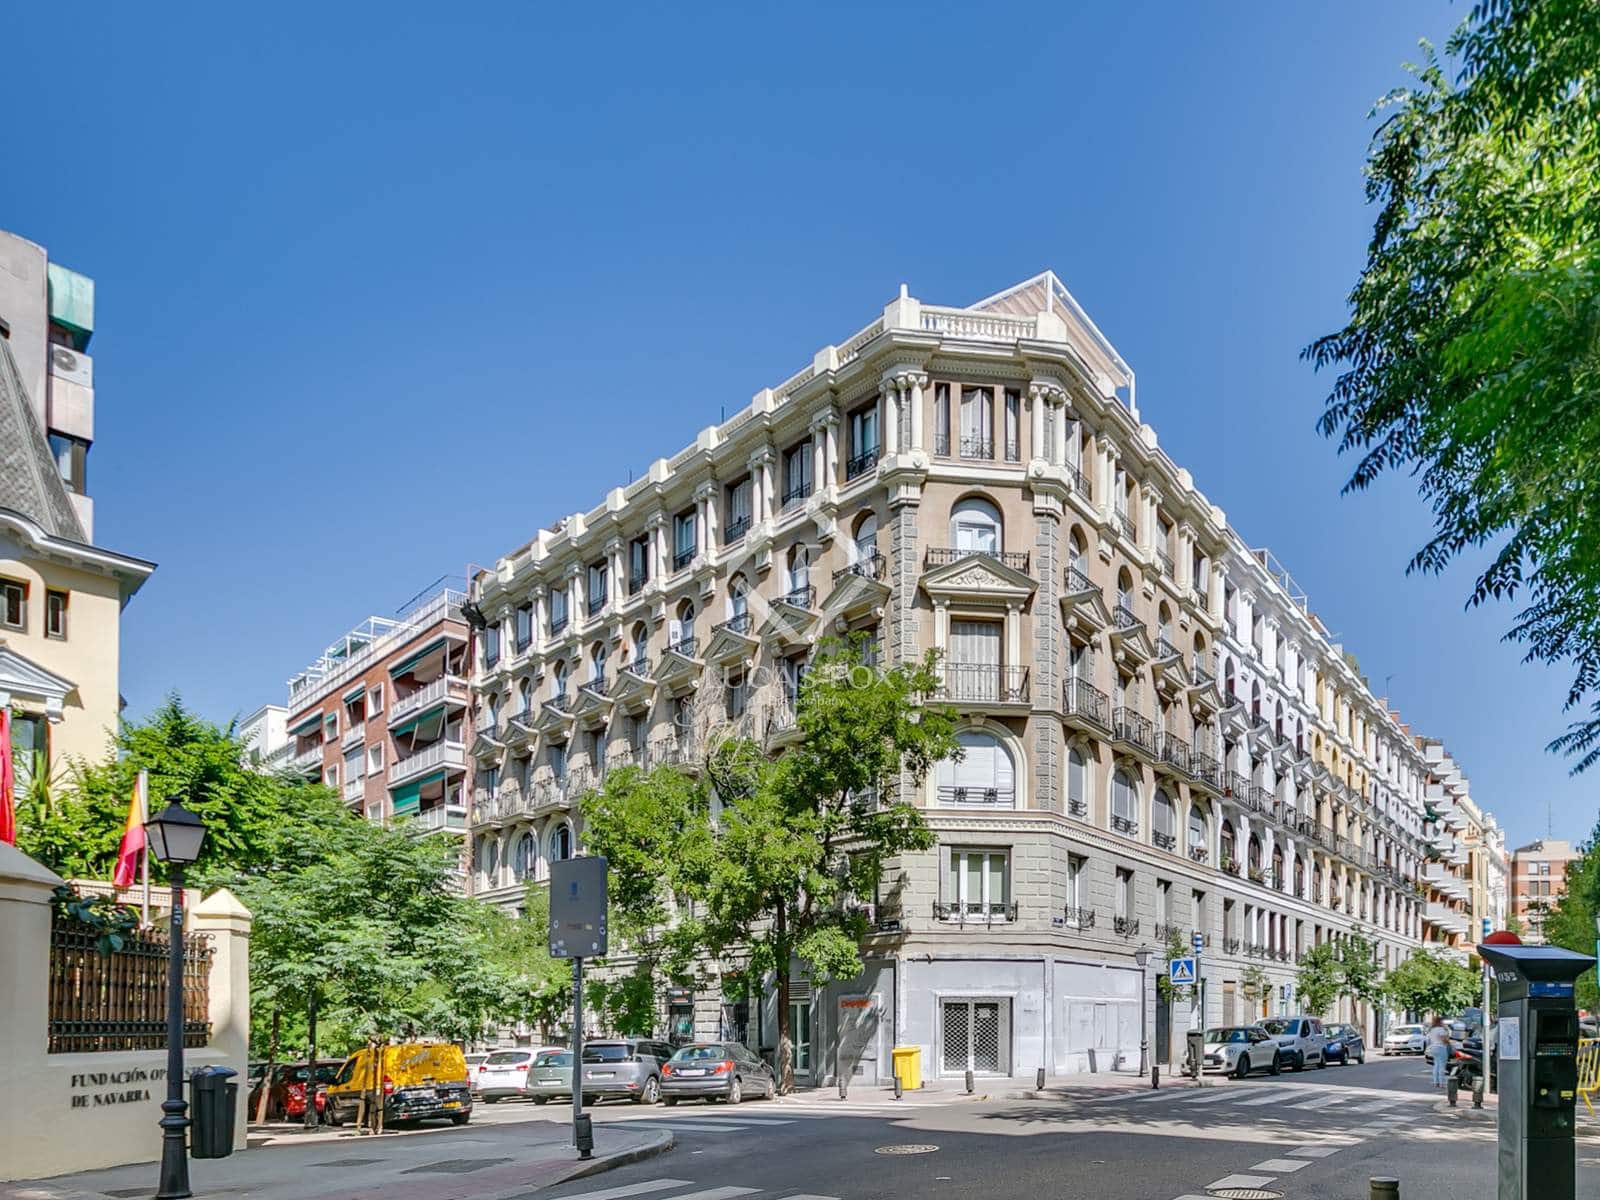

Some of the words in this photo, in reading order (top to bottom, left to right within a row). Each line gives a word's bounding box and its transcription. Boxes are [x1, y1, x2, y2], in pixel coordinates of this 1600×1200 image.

[71, 1067, 147, 1088] FUNDACIÓN
[71, 1094, 90, 1108] DE
[93, 1089, 150, 1106] NAVARRA
